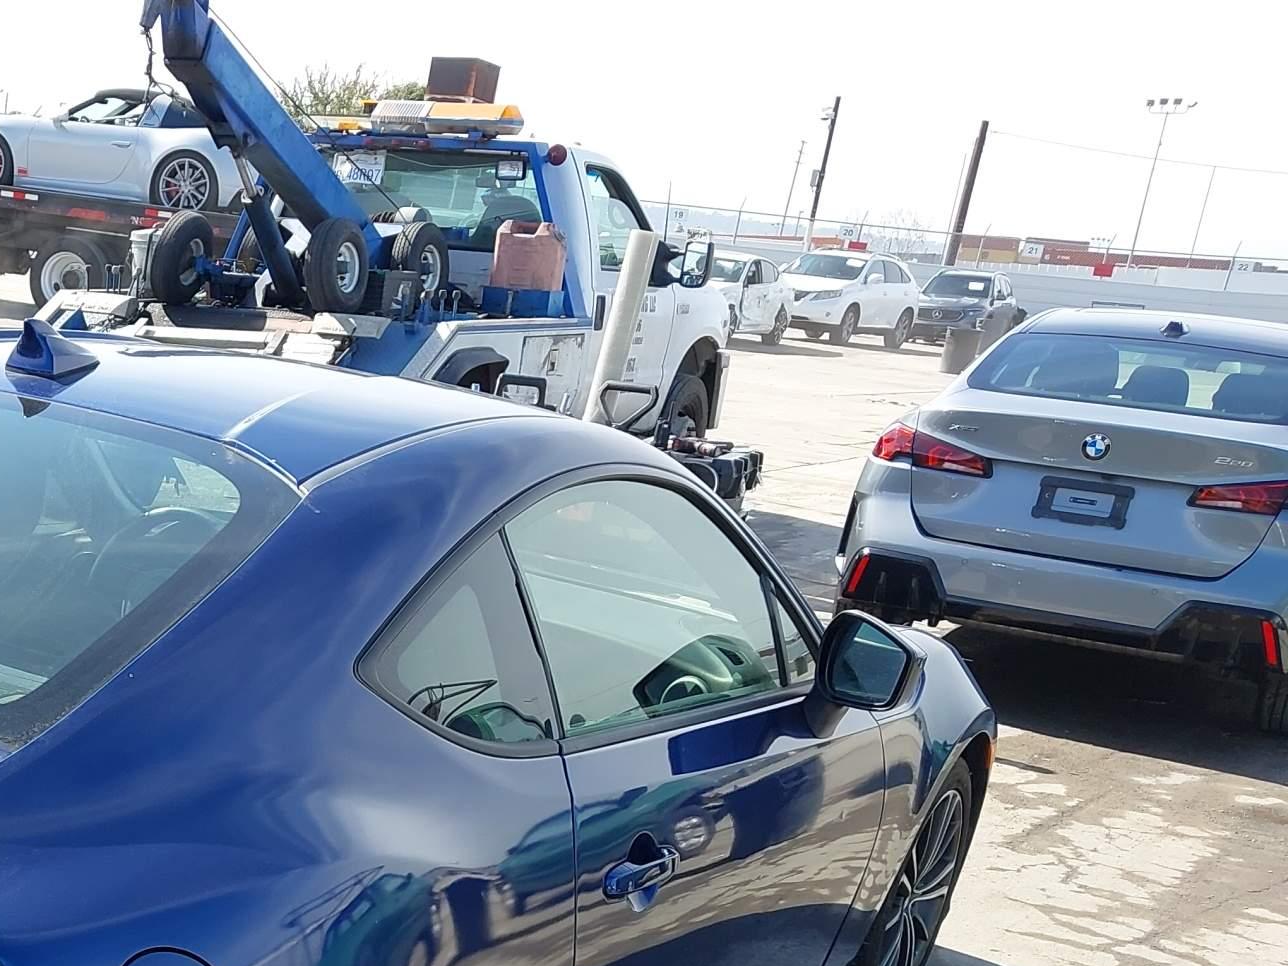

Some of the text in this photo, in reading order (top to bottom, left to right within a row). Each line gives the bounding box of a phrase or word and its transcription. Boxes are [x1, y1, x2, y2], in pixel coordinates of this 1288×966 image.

[674, 210, 684, 219] 19
[842, 228, 854, 237] 20
[1027, 246, 1038, 255] 21
[1237, 263, 1249, 272] 22
